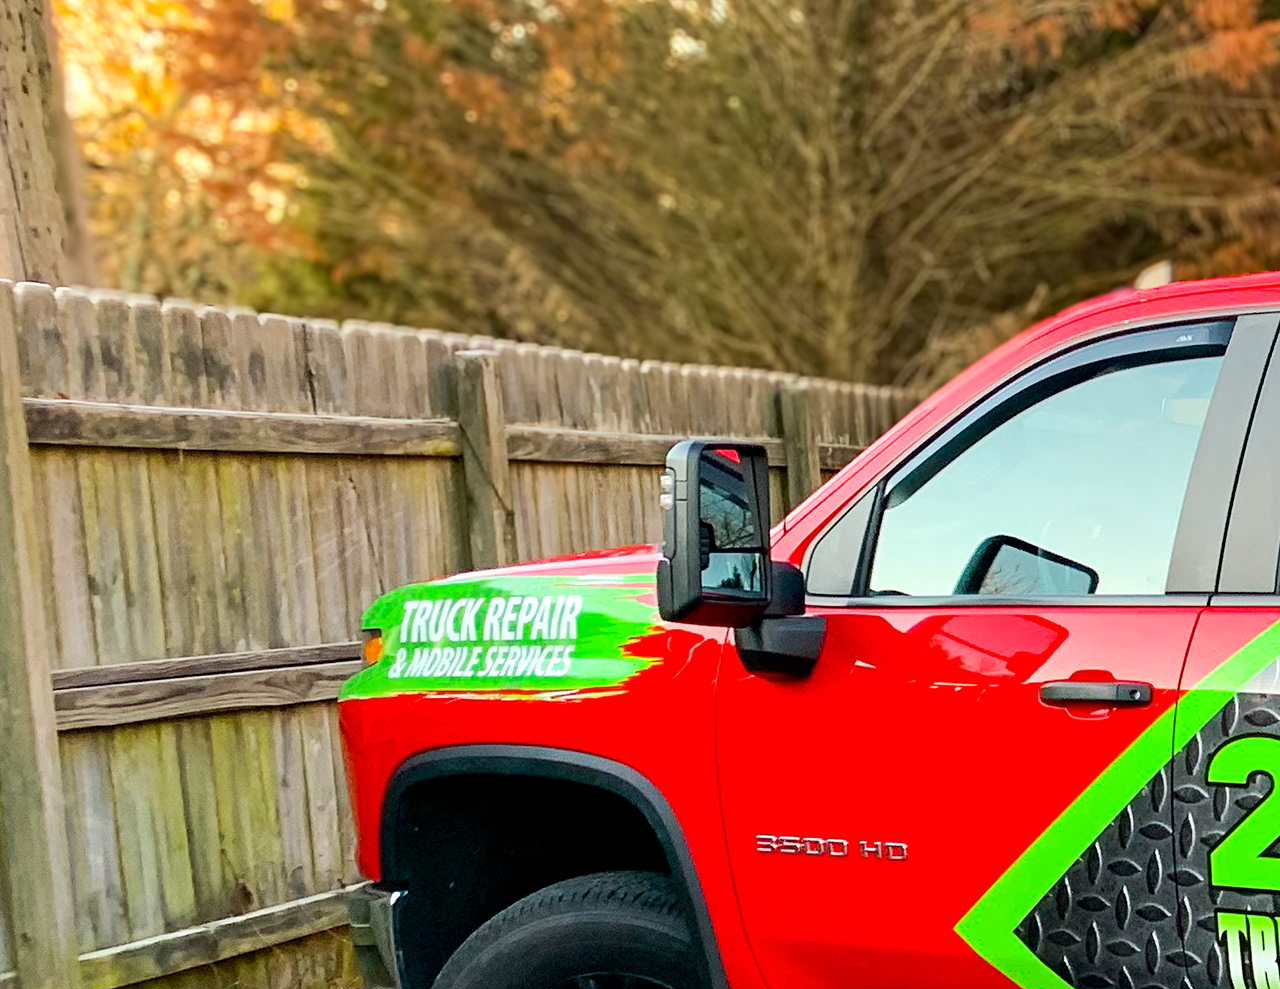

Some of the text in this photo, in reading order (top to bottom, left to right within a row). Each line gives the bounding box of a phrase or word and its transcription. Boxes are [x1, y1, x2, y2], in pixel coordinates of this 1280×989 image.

[400, 595, 583, 643] TRUCK REPAIR
[388, 645, 575, 678] & MOBILE SERVICES
[756, 834, 908, 860] 3500 HD
